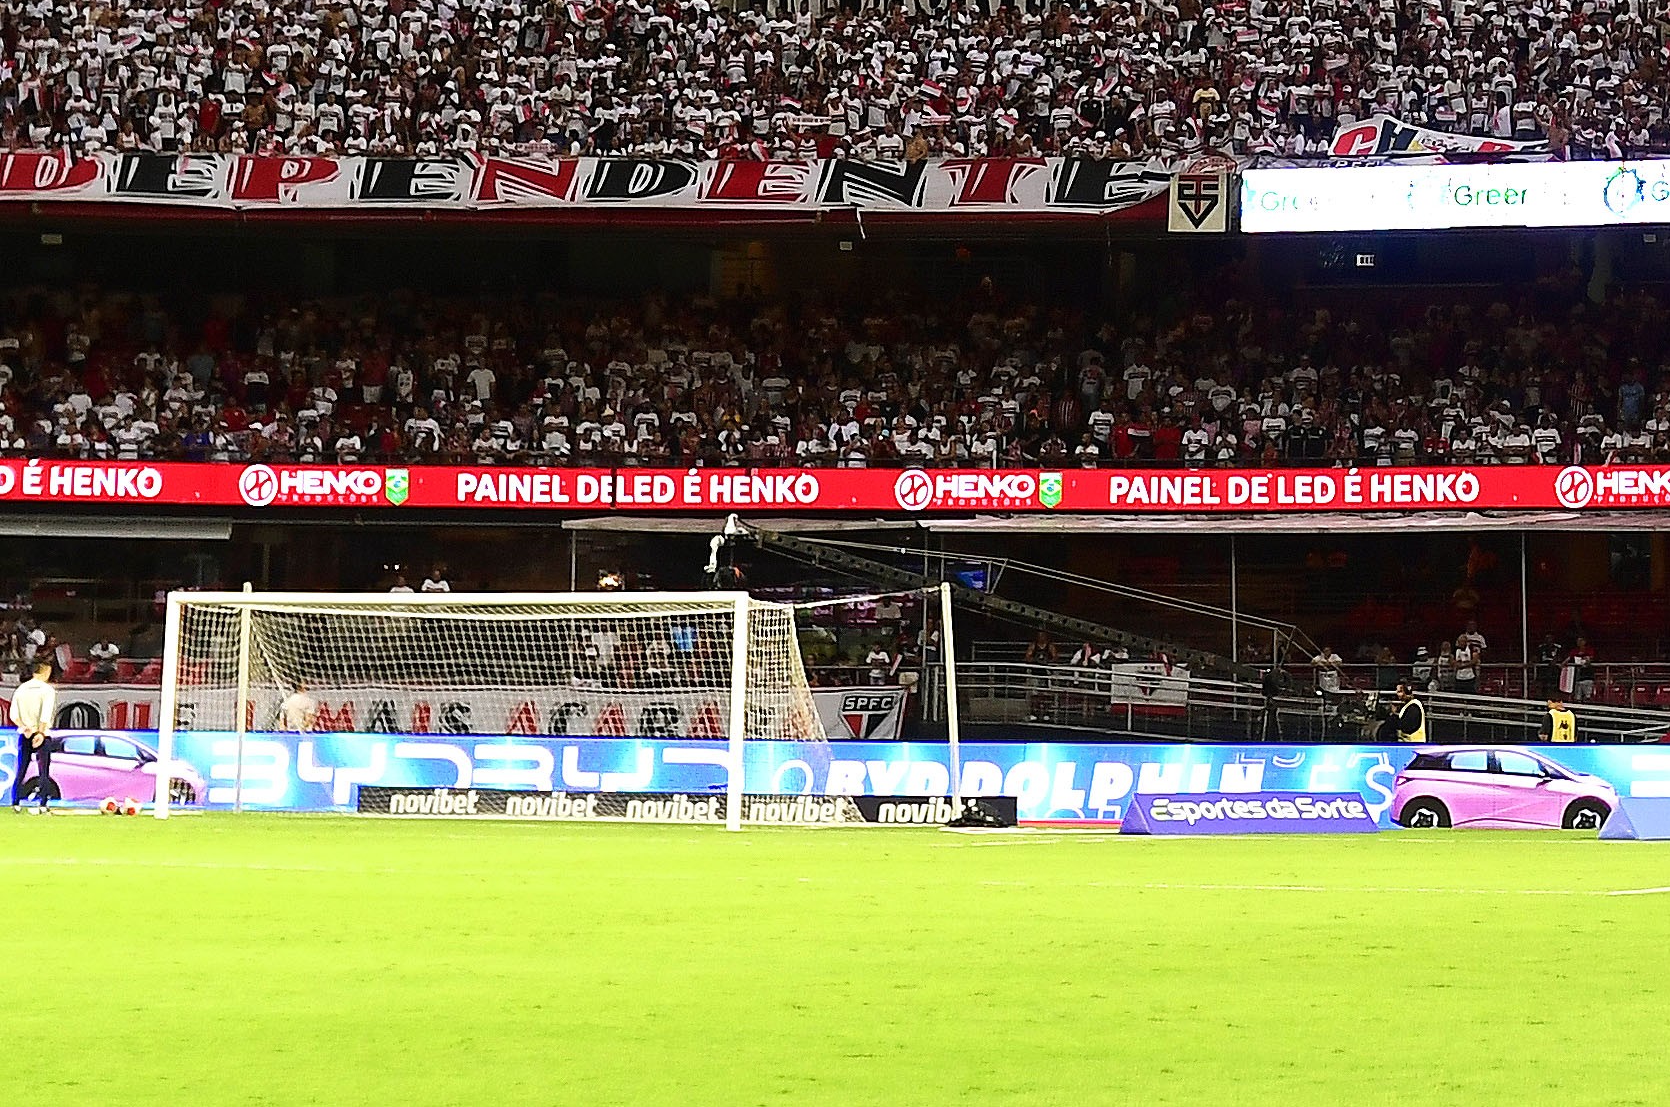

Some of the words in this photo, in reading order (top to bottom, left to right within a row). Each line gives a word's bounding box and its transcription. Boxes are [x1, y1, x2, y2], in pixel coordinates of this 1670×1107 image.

[22, 458, 44, 495] É
[49, 466, 163, 498] HENKO
[281, 470, 382, 495] HENKO
[456, 473, 569, 503] PAINEL
[576, 474, 613, 503] DE
[616, 474, 676, 503] LED
[683, 467, 702, 503] É
[709, 473, 820, 503] HENKO
[935, 474, 1036, 498] HENKO
[1109, 474, 1221, 504] PAINEL
[1228, 473, 1271, 504] DE
[1277, 474, 1336, 504] LED
[1344, 468, 1363, 504] É
[1371, 471, 1480, 503] HENKO
[844, 696, 893, 711] SPFC
[389, 789, 479, 815] novibet
[957, 761, 1264, 819] DOLPHIN
[505, 793, 598, 818] novibet
[626, 795, 721, 822] novibet
[750, 797, 846, 823] novibet
[878, 796, 965, 824] novib
